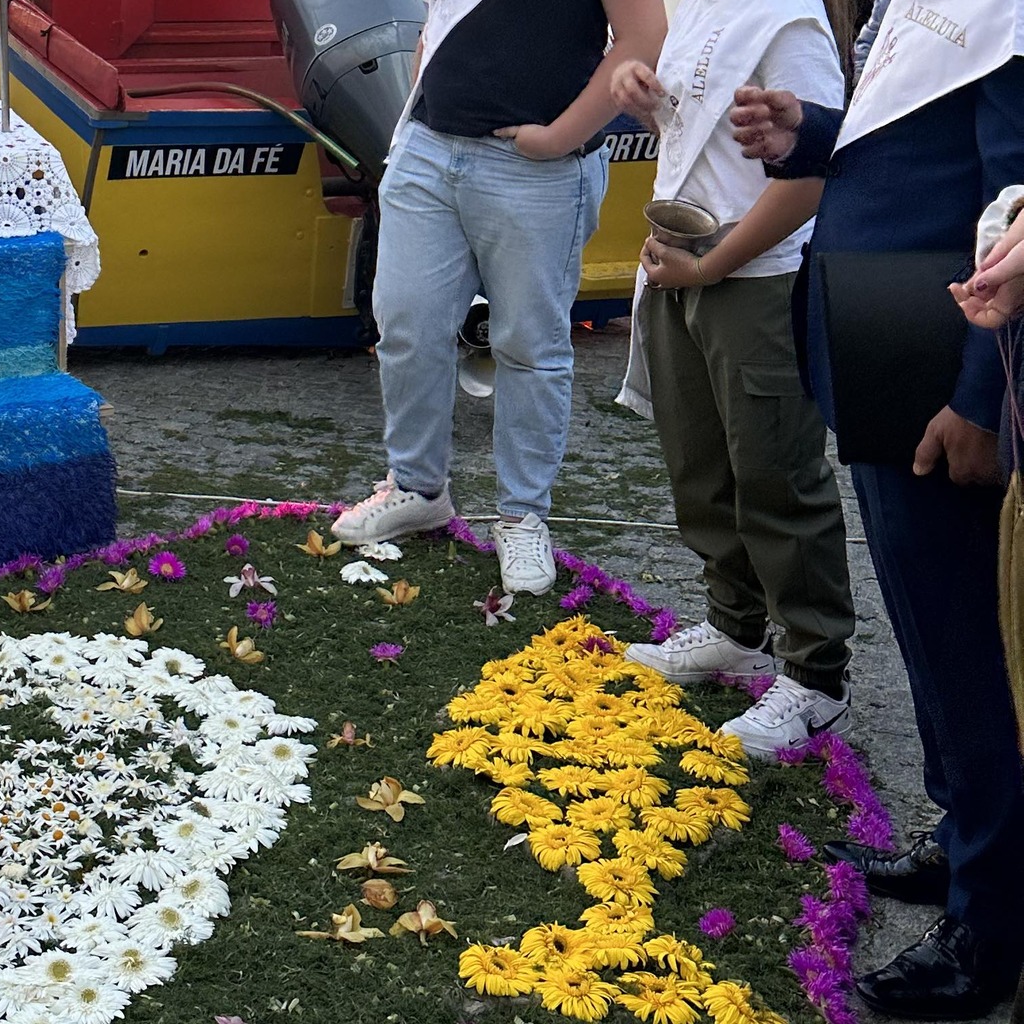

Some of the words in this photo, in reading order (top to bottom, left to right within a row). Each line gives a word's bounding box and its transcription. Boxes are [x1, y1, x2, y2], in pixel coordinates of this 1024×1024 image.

[904, 0, 967, 49] ALELUIA
[691, 27, 725, 105] ALELUIA
[125, 148, 206, 177] MARIA
[212, 147, 245, 174] DA
[250, 143, 284, 173] FÉ
